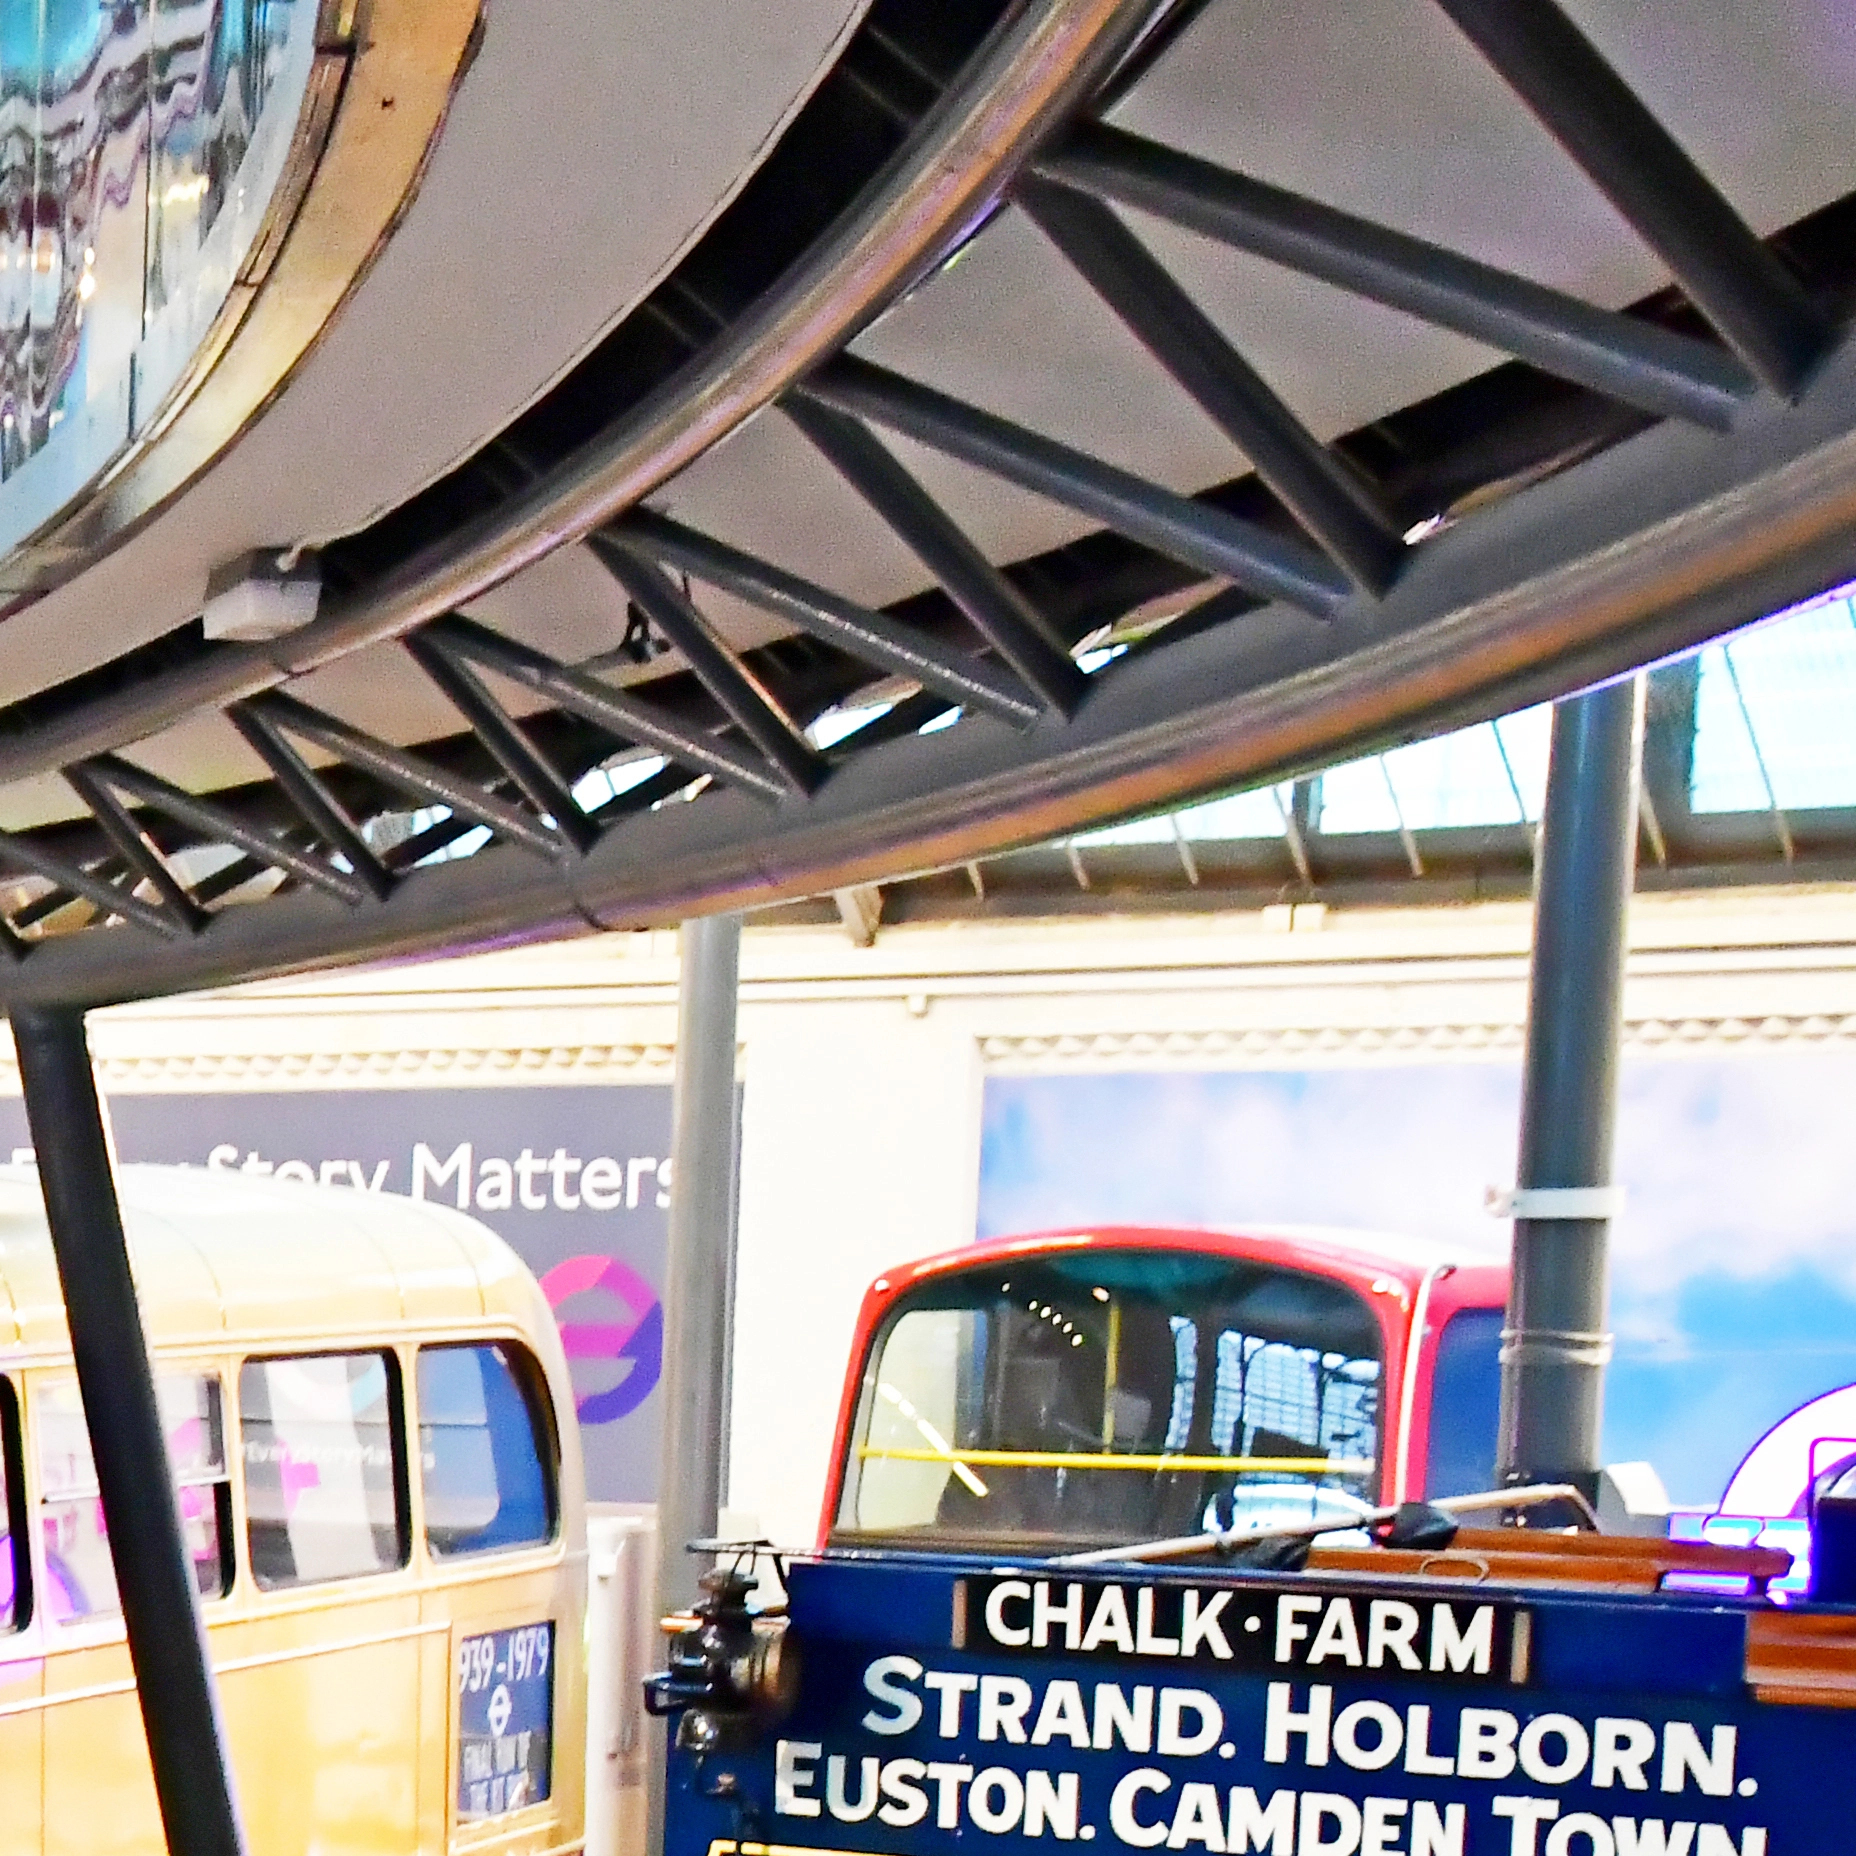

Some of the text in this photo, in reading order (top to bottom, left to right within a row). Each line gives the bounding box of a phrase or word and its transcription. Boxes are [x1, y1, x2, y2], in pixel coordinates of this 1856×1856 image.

[984, 1580, 1495, 1675] CHALK FARM
[861, 1655, 1759, 1799] STRAND. HOLBORN.
[773, 1739, 1097, 1840] EUSTON.
